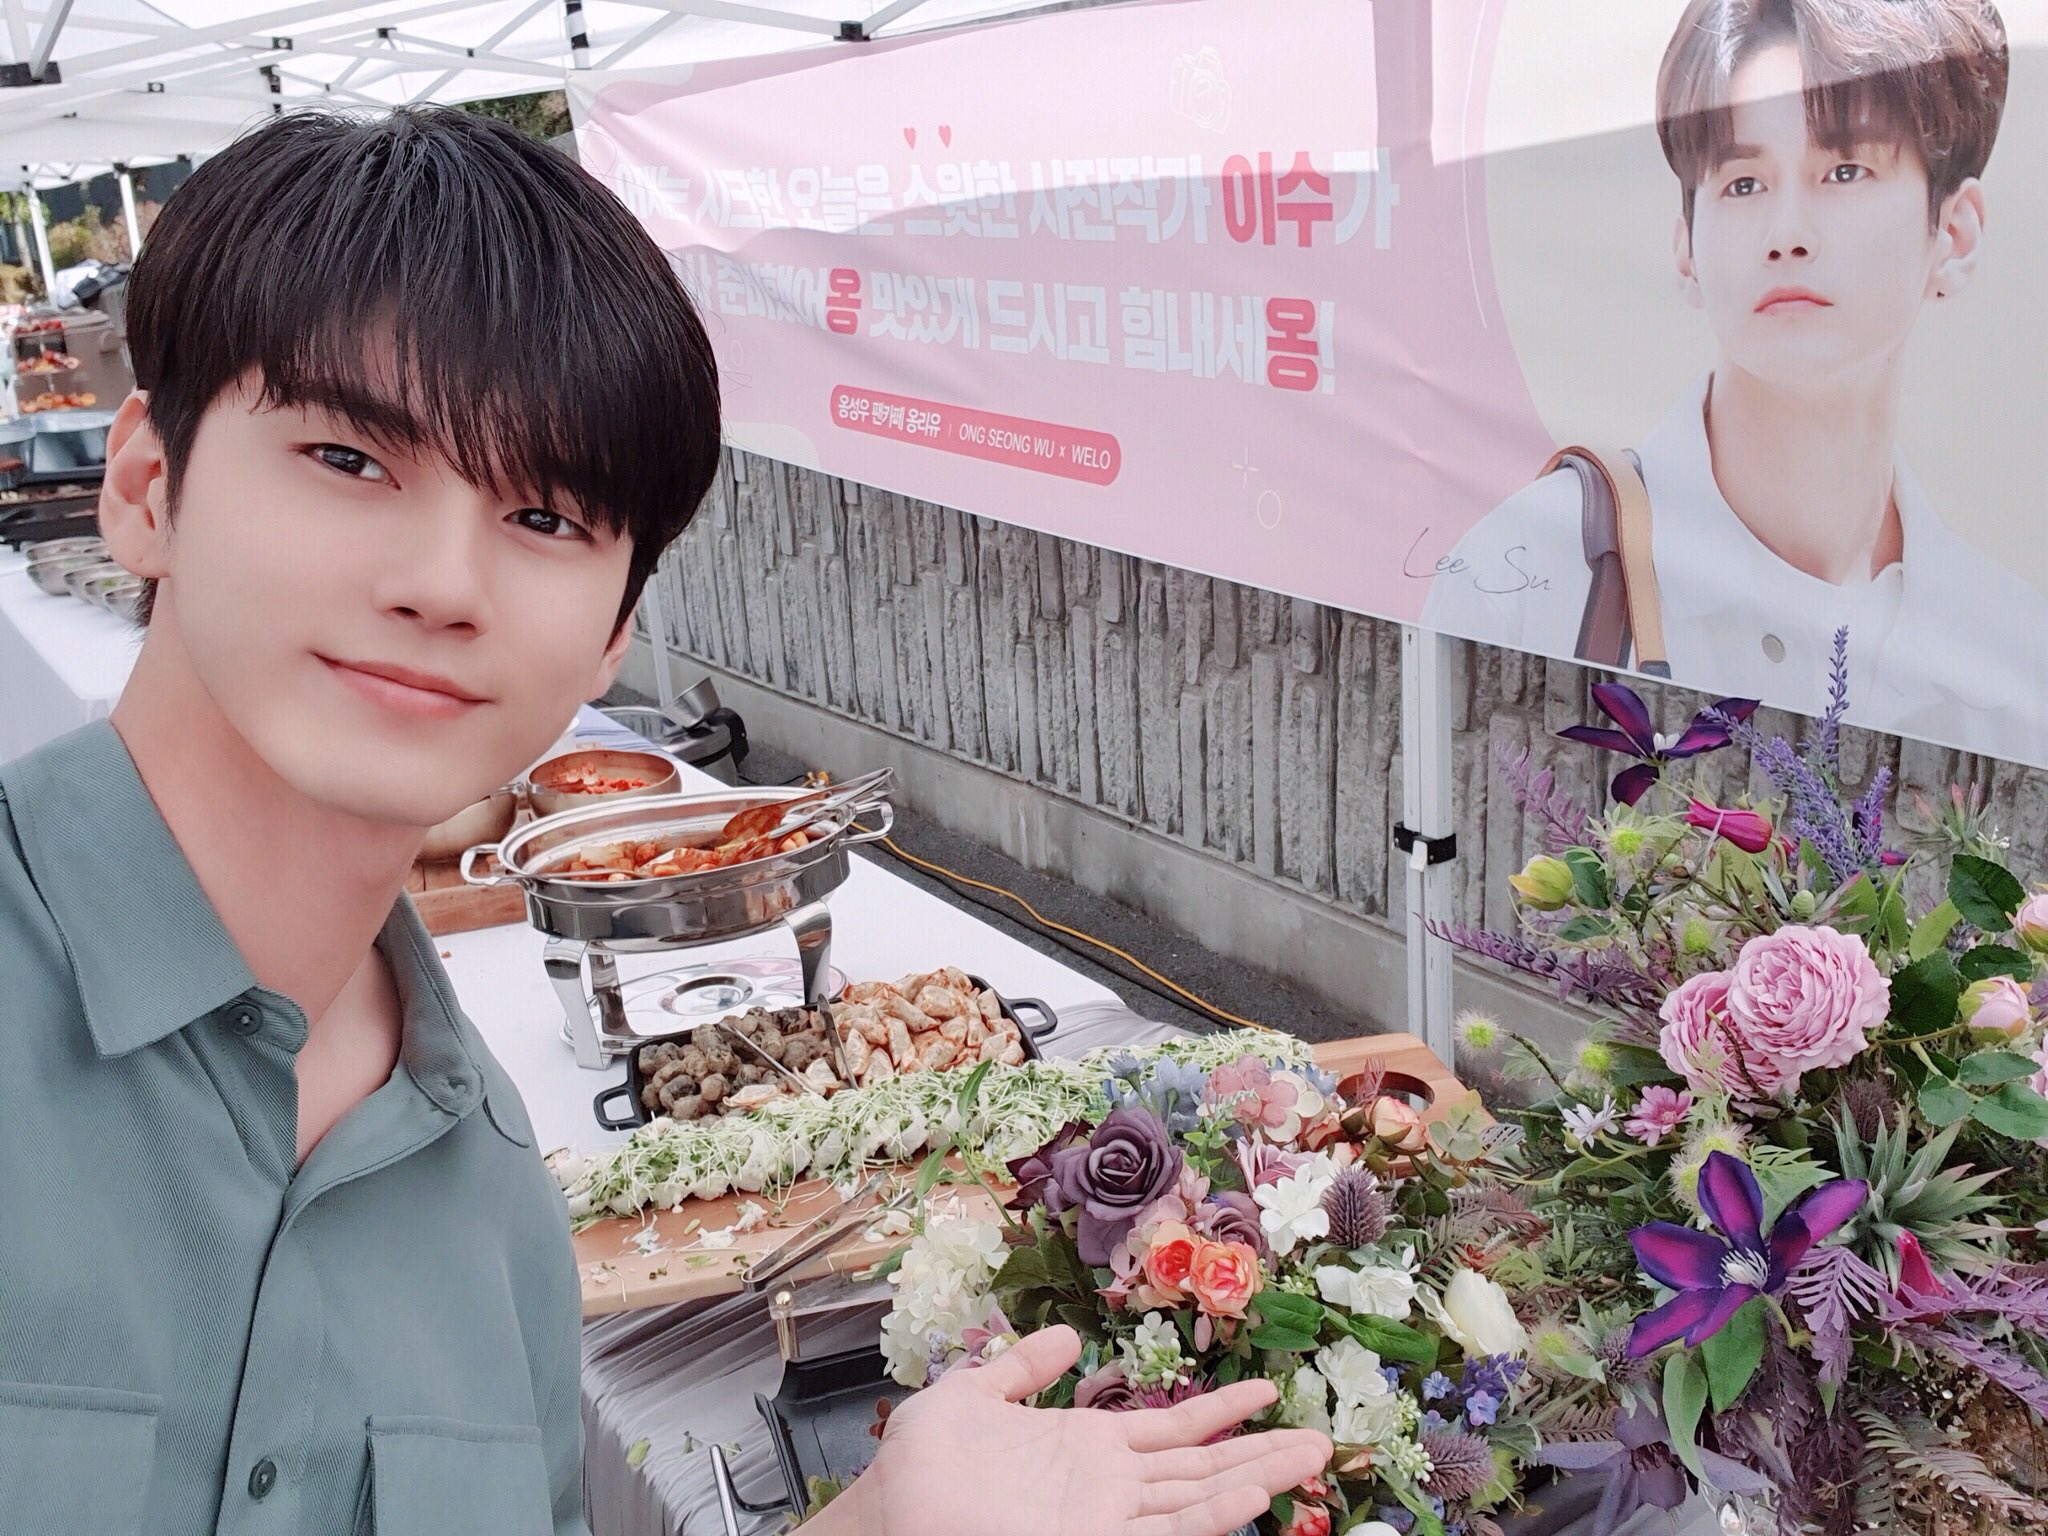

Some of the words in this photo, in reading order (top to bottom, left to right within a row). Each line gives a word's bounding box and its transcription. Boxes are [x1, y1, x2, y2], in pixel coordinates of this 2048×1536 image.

[697, 166, 791, 229] 시크한
[786, 164, 896, 237] 오늘은
[903, 159, 1020, 239] 스윗한
[1028, 153, 1212, 245] 사진작가
[1221, 146, 1400, 250] 이수가
[869, 271, 981, 350] 맛있게
[986, 279, 1111, 365] 드시고
[1119, 286, 1336, 396] 힘내세옹!
[838, 394, 870, 423] 옹성우
[871, 401, 906, 431] 팬카페
[906, 408, 942, 438] 옹리유
[959, 423, 985, 444] ONG
[987, 428, 1031, 454] SEONG
[1033, 437, 1055, 459] WU
[1071, 443, 1112, 470] WELO
